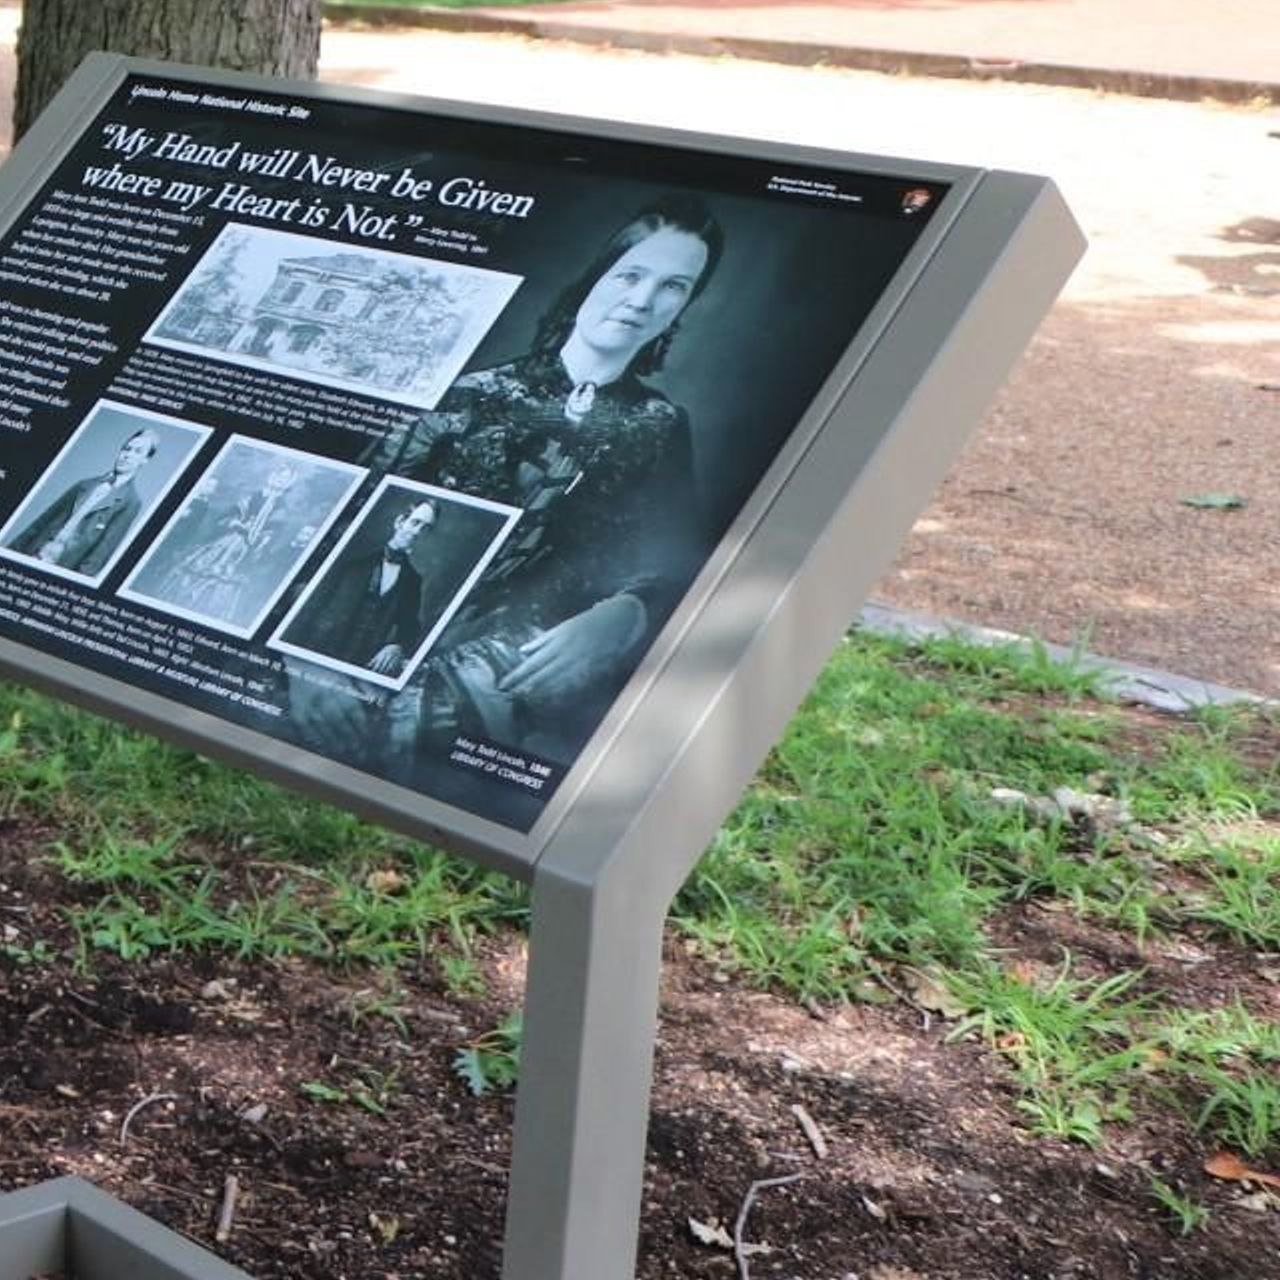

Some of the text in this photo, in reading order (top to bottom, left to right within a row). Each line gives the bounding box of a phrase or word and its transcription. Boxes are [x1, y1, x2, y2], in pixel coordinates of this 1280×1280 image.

[131, 85, 310, 119] Lincoln Home National Historic Site
[103, 123, 534, 217] “My Hand will Never be Given
[81, 162, 424, 241] where my Heart is Not.”
[451, 751, 543, 789] LIBRARY OF CONGRESS
[455, 737, 476, 751] Mary
[477, 744, 497, 757] Todd
[496, 752, 525, 768] Lincoln,
